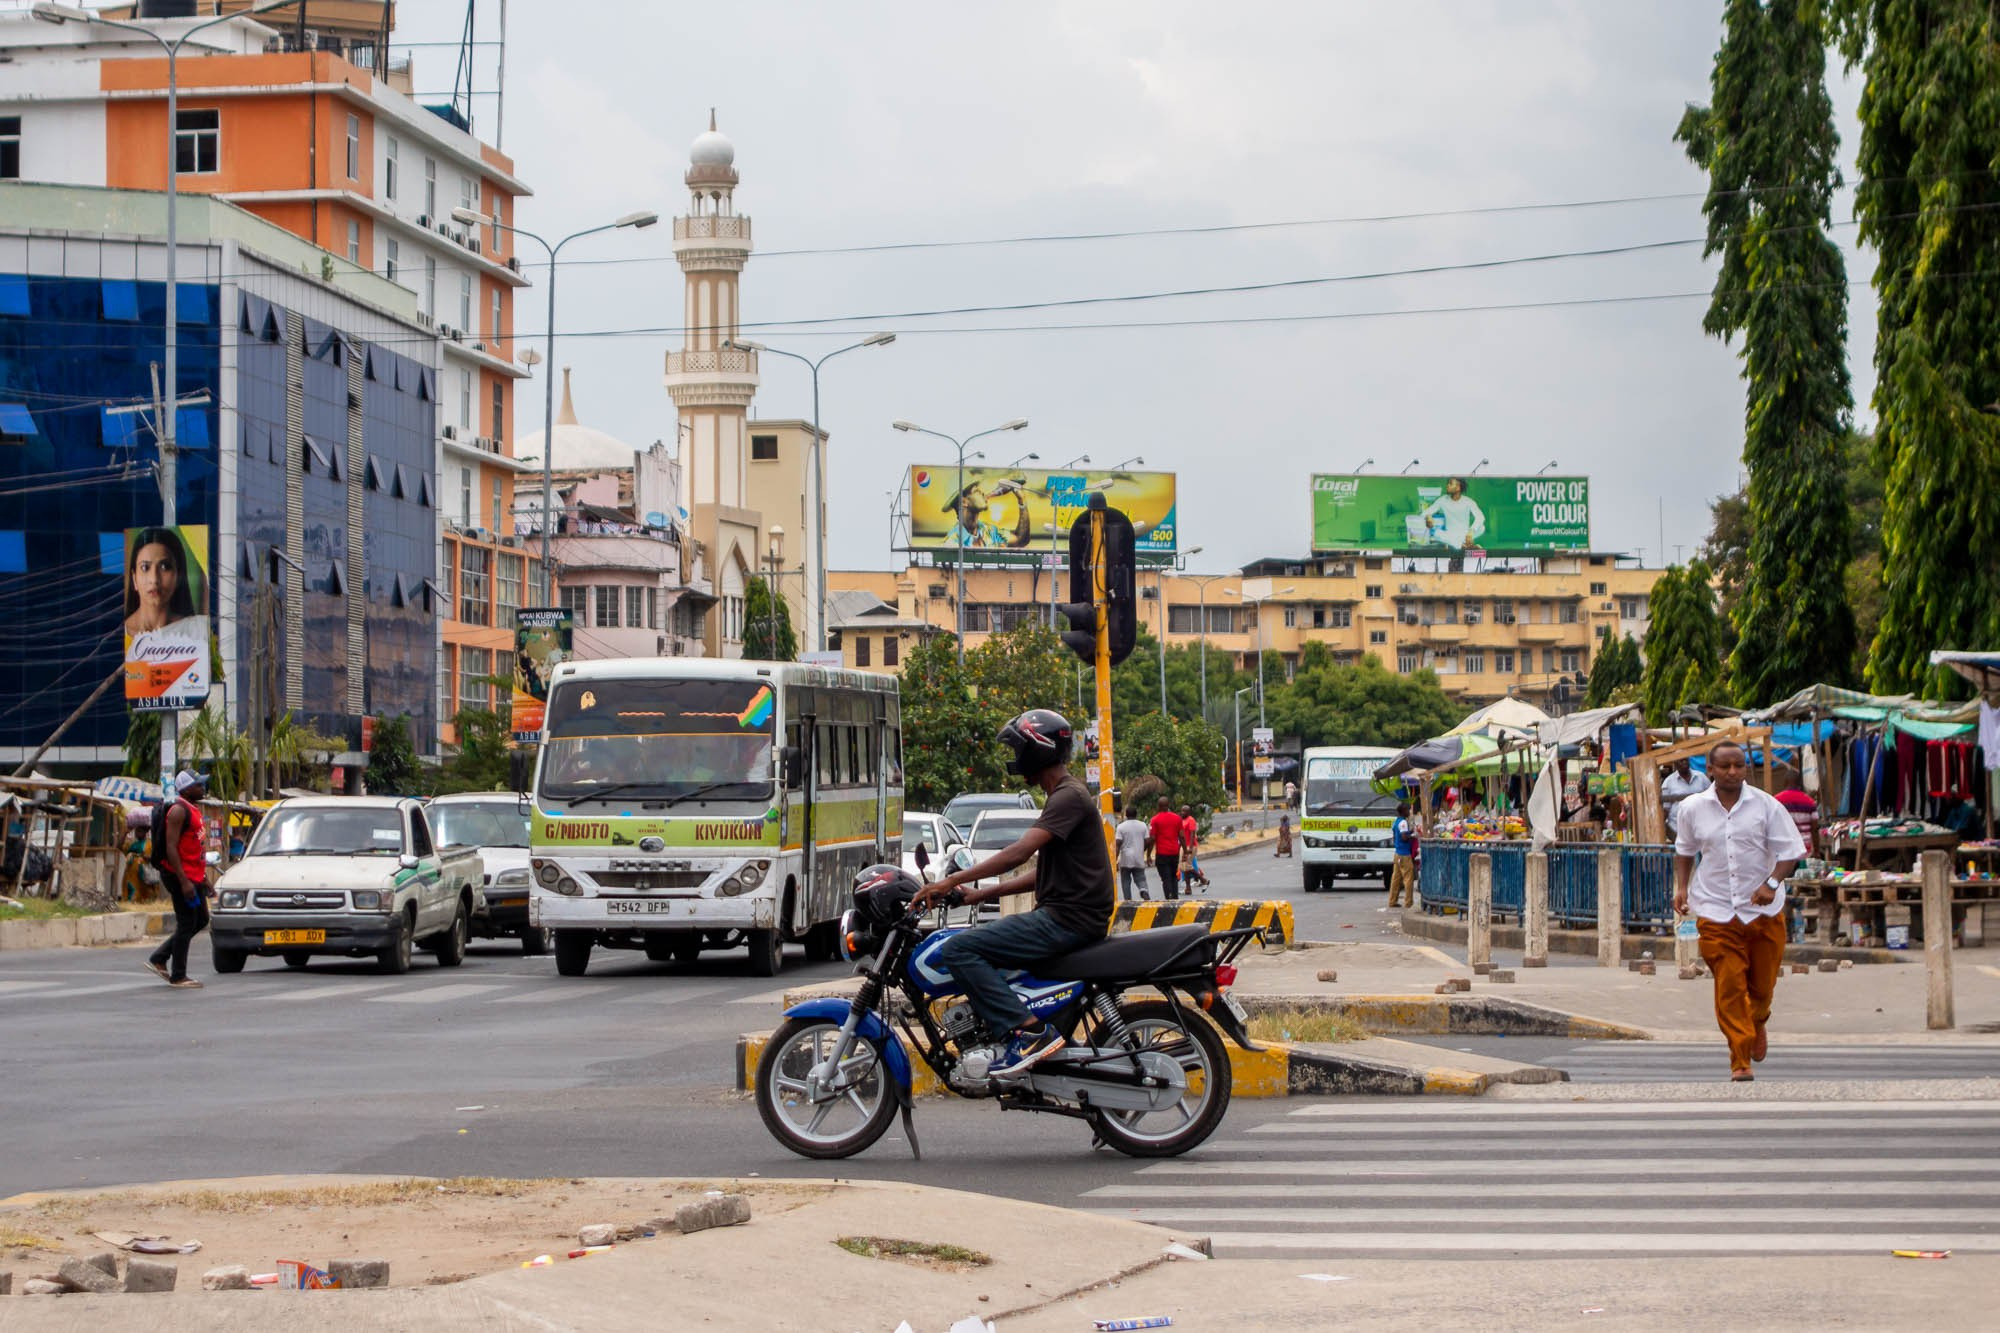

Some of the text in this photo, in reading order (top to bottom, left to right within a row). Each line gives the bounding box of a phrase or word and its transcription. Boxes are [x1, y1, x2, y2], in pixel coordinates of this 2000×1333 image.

[1314, 478, 1360, 491] Coral
[1517, 481, 1587, 501] POWER OF
[1533, 503, 1587, 524] COLOUR
[535, 611, 565, 620] KUBWA
[138, 696, 187, 707] ASHTON
[545, 822, 609, 840] G/MBOTO
[695, 823, 763, 841] KIVUKONI
[615, 902, 668, 913] T542 DFP
[280, 932, 296, 942] 981
